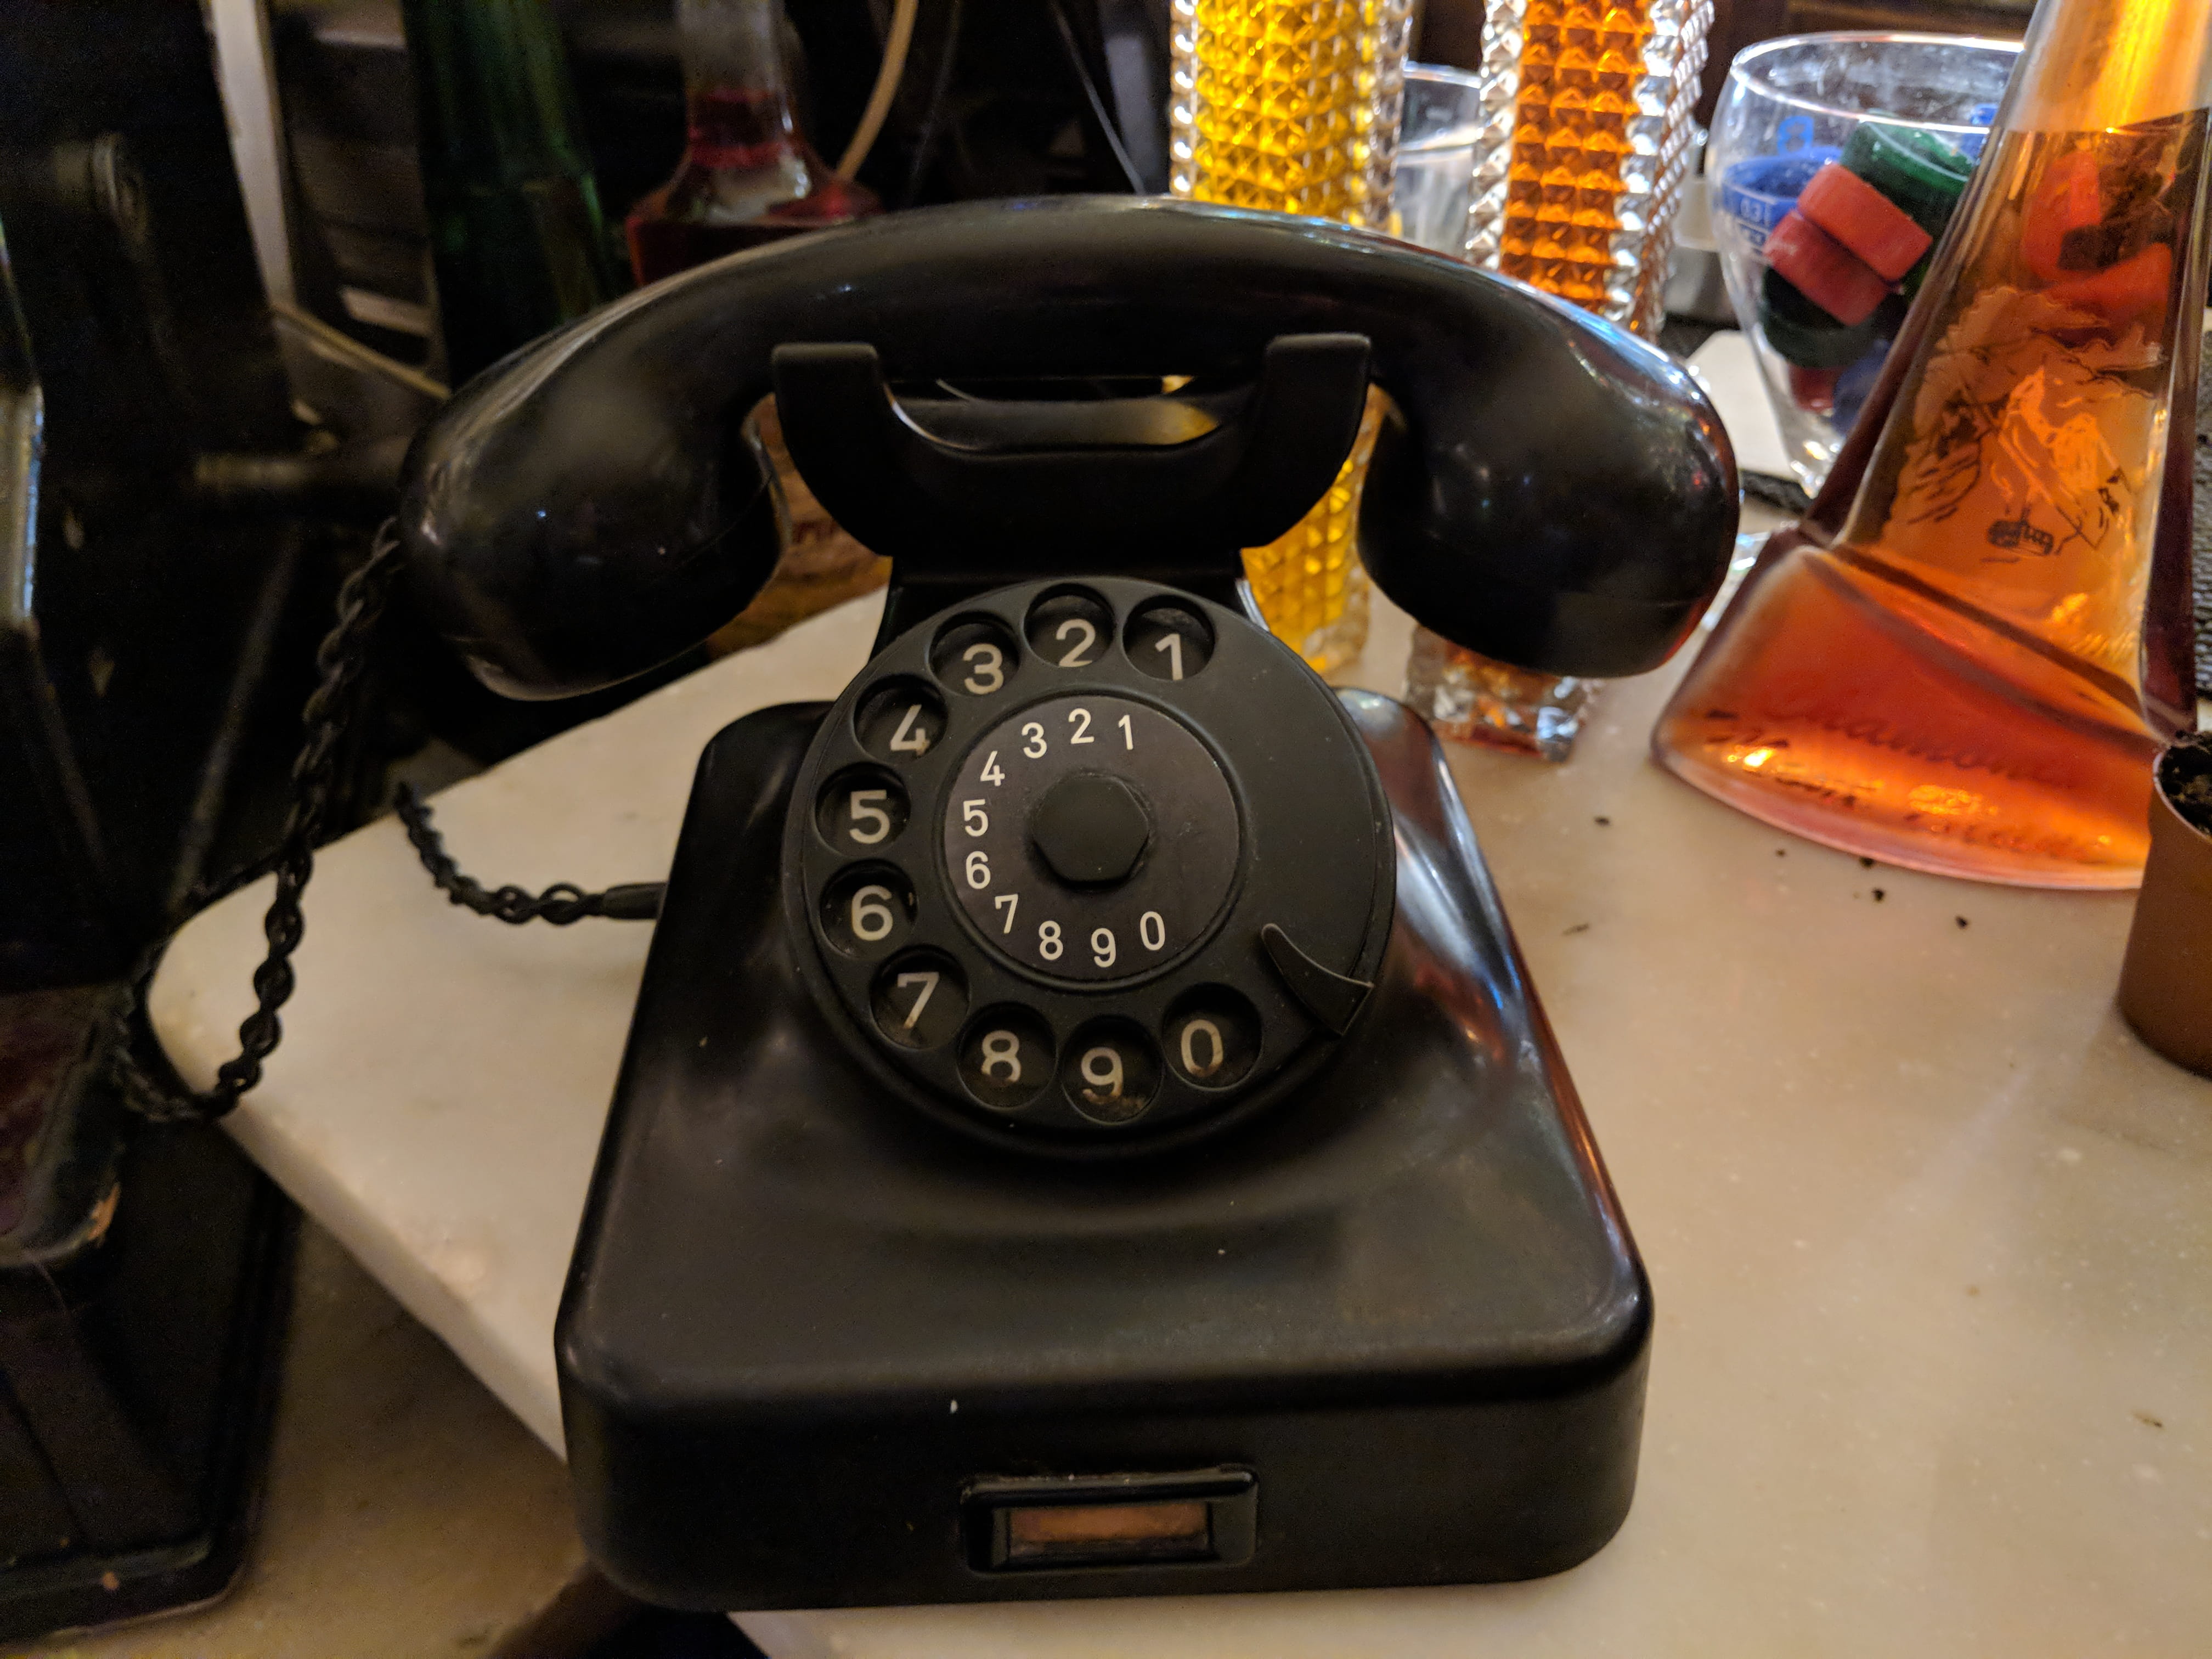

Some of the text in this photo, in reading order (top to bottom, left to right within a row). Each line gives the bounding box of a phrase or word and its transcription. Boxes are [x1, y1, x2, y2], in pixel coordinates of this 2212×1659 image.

[1055, 618, 1096, 668] 2
[1154, 633, 1183, 681] 1
[962, 643, 1004, 695] 3
[889, 704, 930, 754] 4
[1021, 721, 1048, 759] 3
[1068, 708, 1095, 744] 2
[1117, 714, 1134, 751] 1
[979, 750, 1006, 787] 4
[849, 790, 890, 845] 5
[962, 798, 989, 837] 5
[965, 850, 991, 890] 6
[851, 885, 894, 941] 6
[994, 893, 1019, 934] 7
[1139, 911, 1166, 951] 0
[1038, 920, 1064, 961] 8
[1090, 927, 1116, 968] 9
[896, 972, 940, 1030] 7
[980, 1030, 1022, 1084] 8
[1180, 1019, 1224, 1075] 0
[1080, 1047, 1124, 1097] 9
